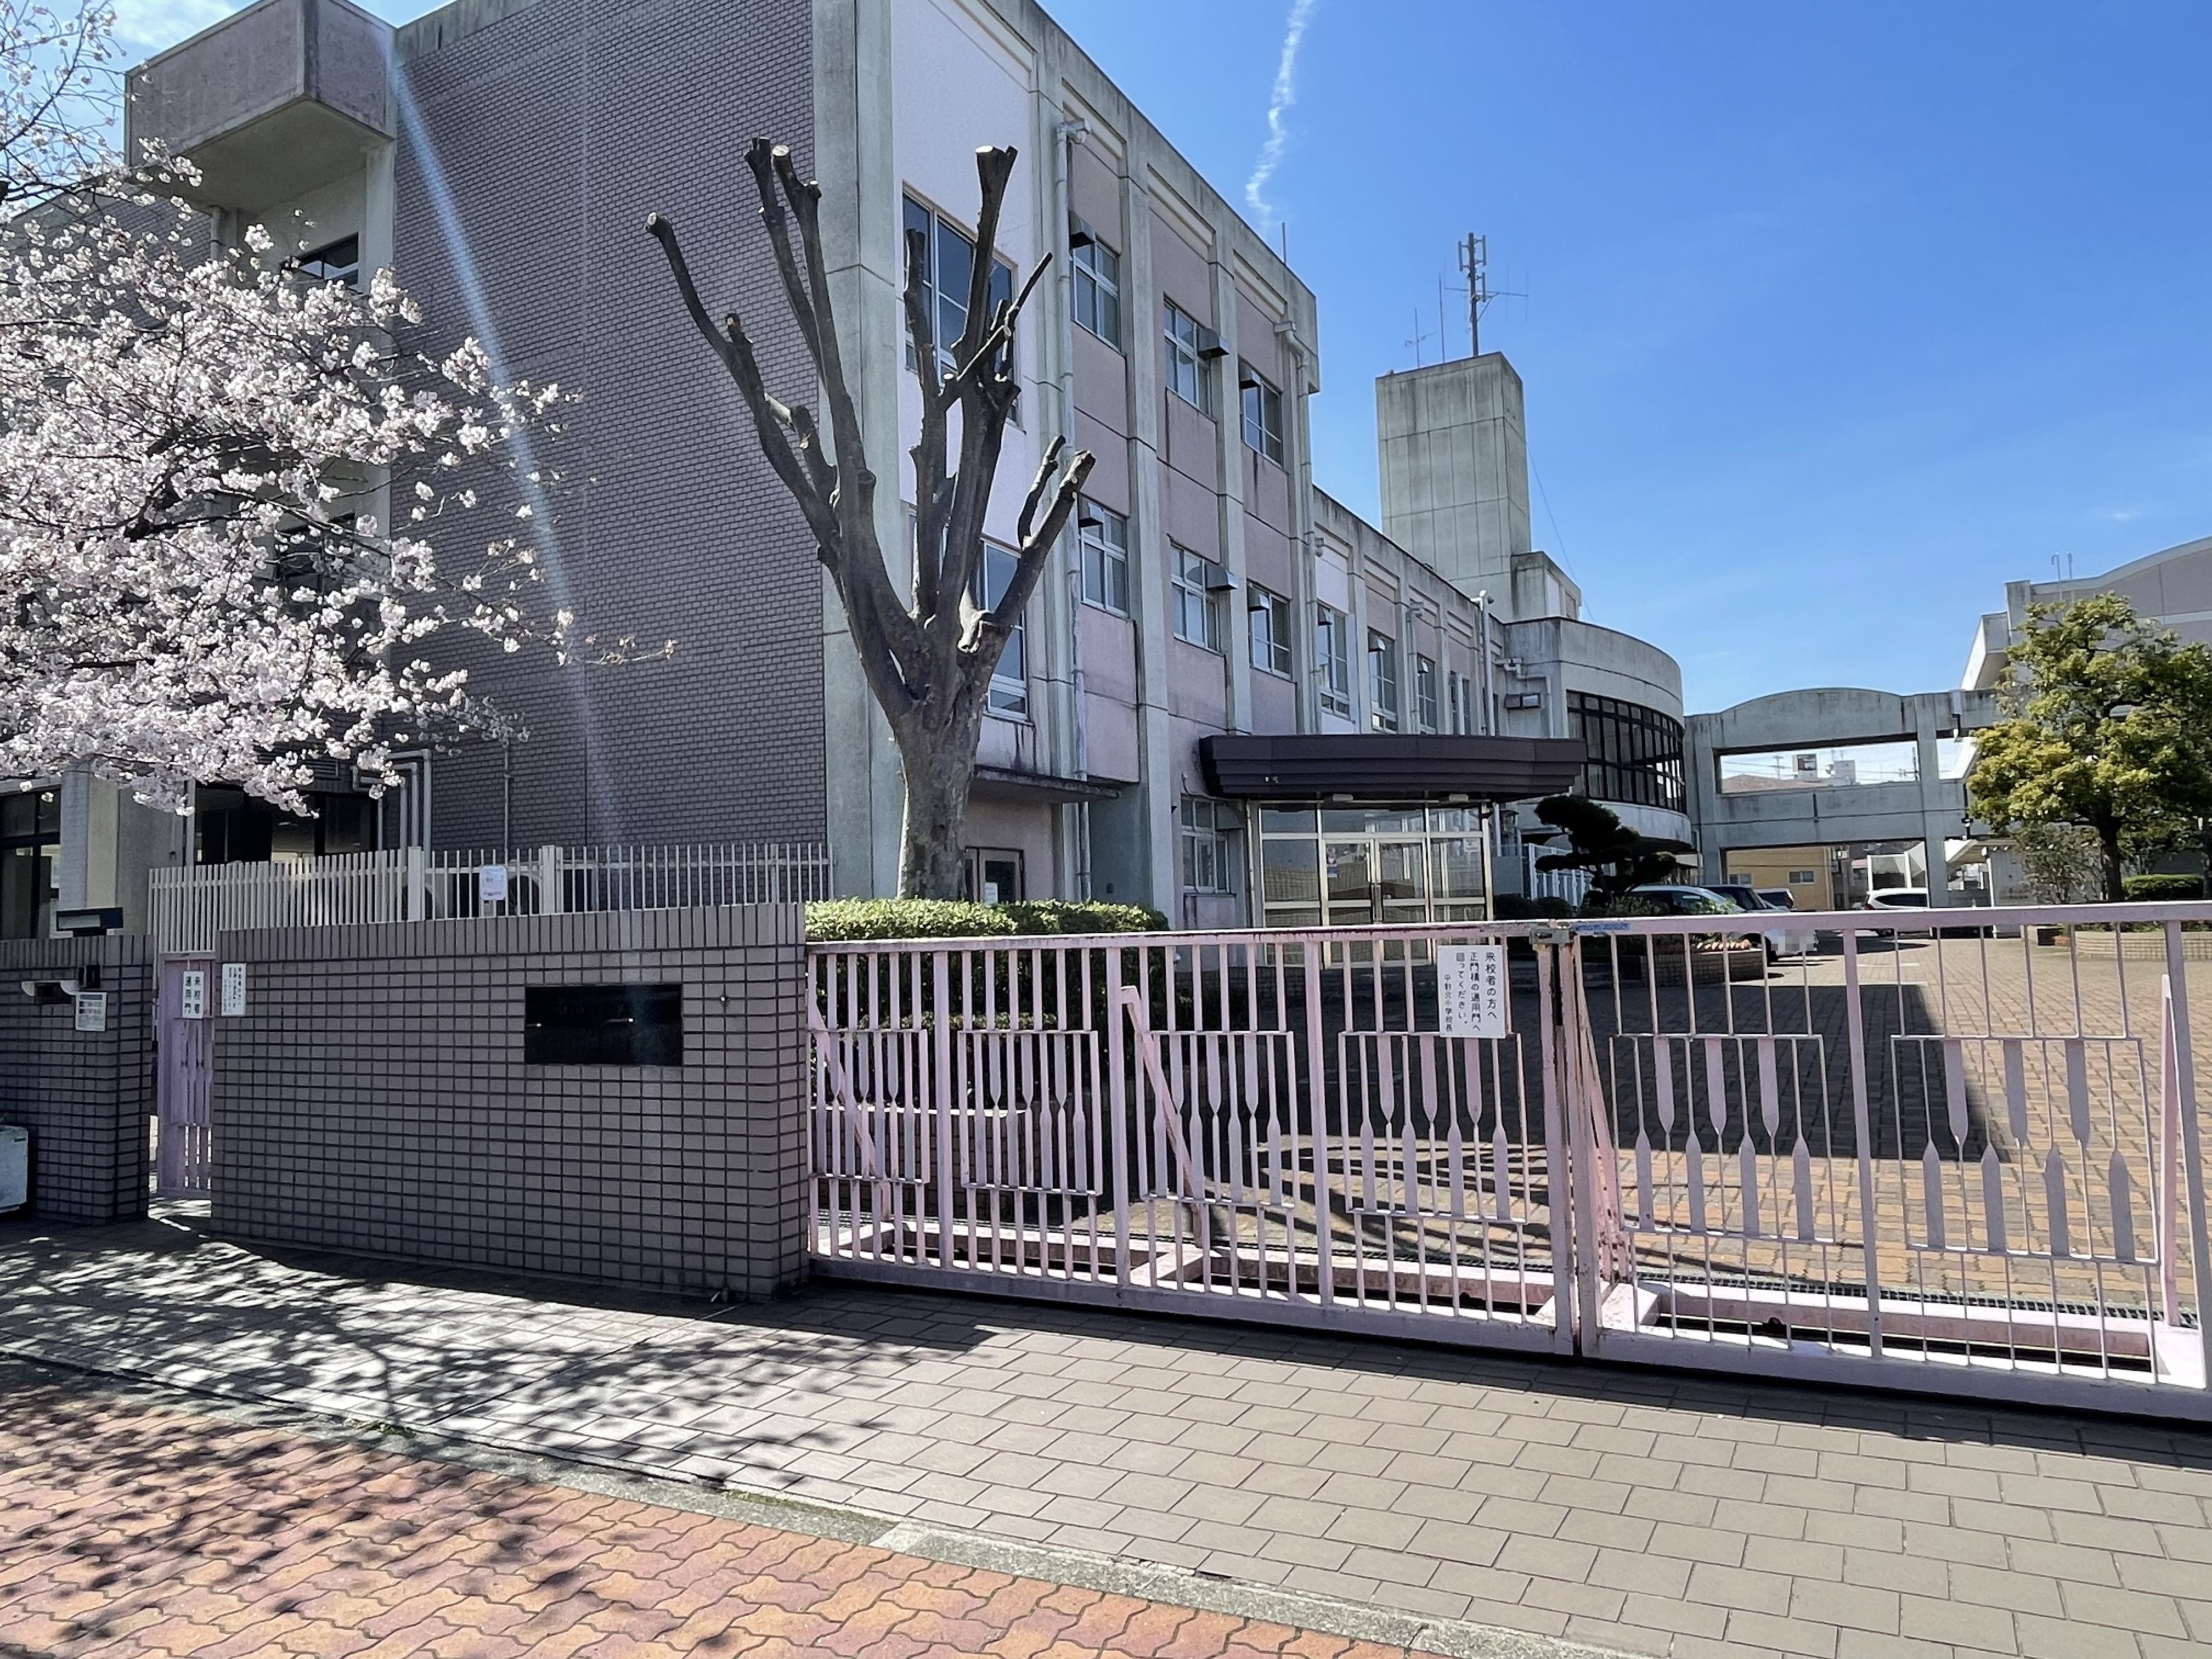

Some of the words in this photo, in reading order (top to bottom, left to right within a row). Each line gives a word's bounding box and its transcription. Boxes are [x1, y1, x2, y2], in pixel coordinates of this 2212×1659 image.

[1486, 952, 1497, 1019] 来校者の方へ
